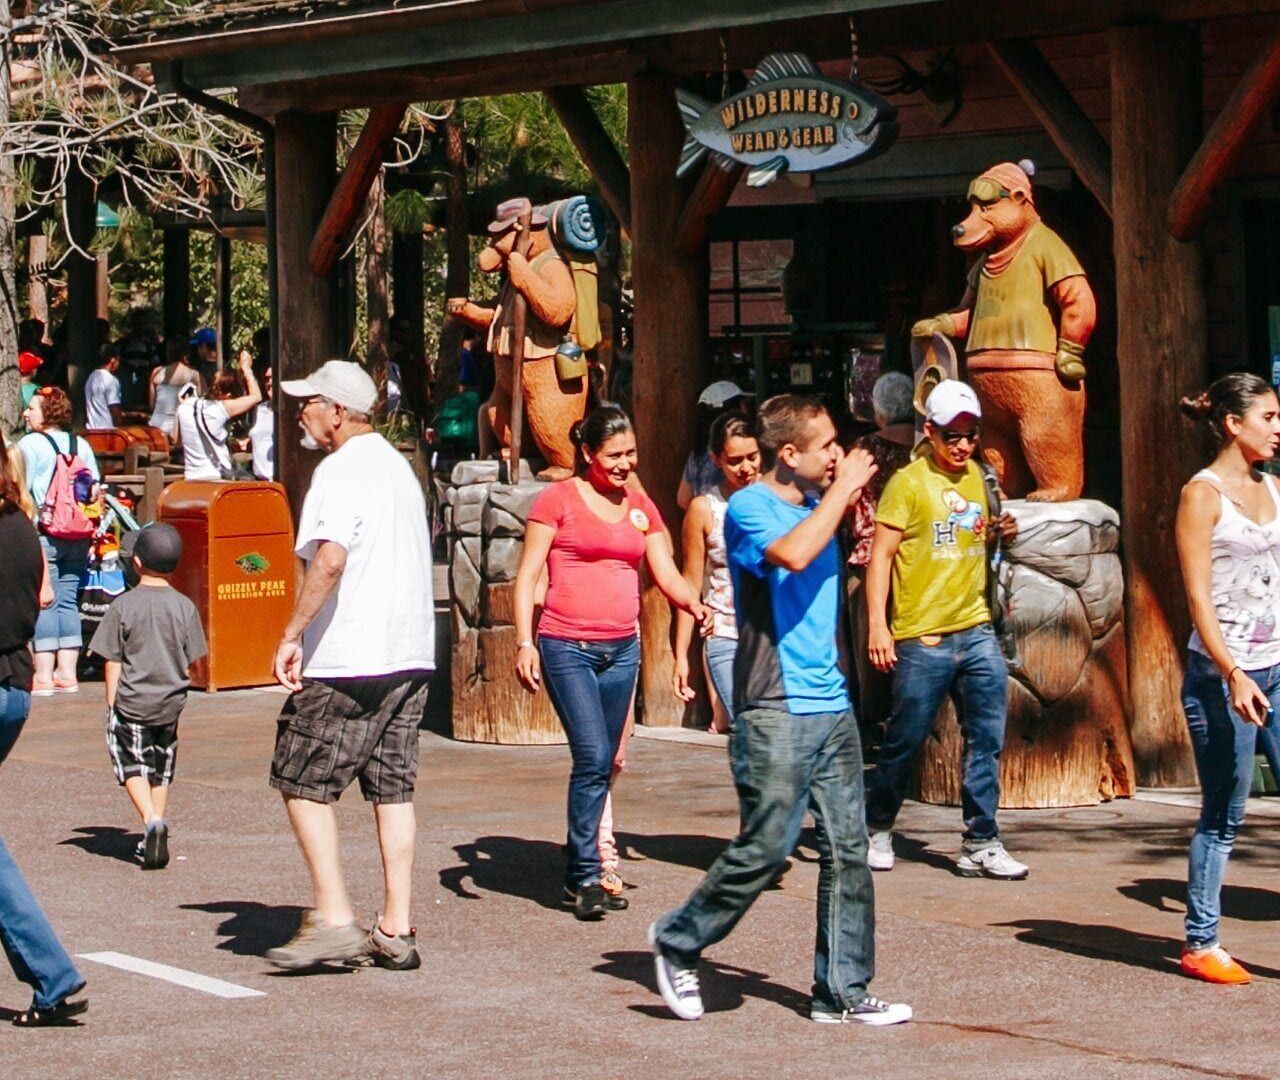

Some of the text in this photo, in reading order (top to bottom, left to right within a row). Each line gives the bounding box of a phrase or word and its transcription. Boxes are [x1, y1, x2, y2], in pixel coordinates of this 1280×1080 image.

[720, 88, 842, 129] WILDERNESS
[731, 130, 776, 153] WEAR
[792, 124, 835, 148] GEAR
[932, 521, 957, 547] H
[217, 579, 286, 594] GRIZZLY PEAK
[217, 589, 286, 600] RECREATION AREA
